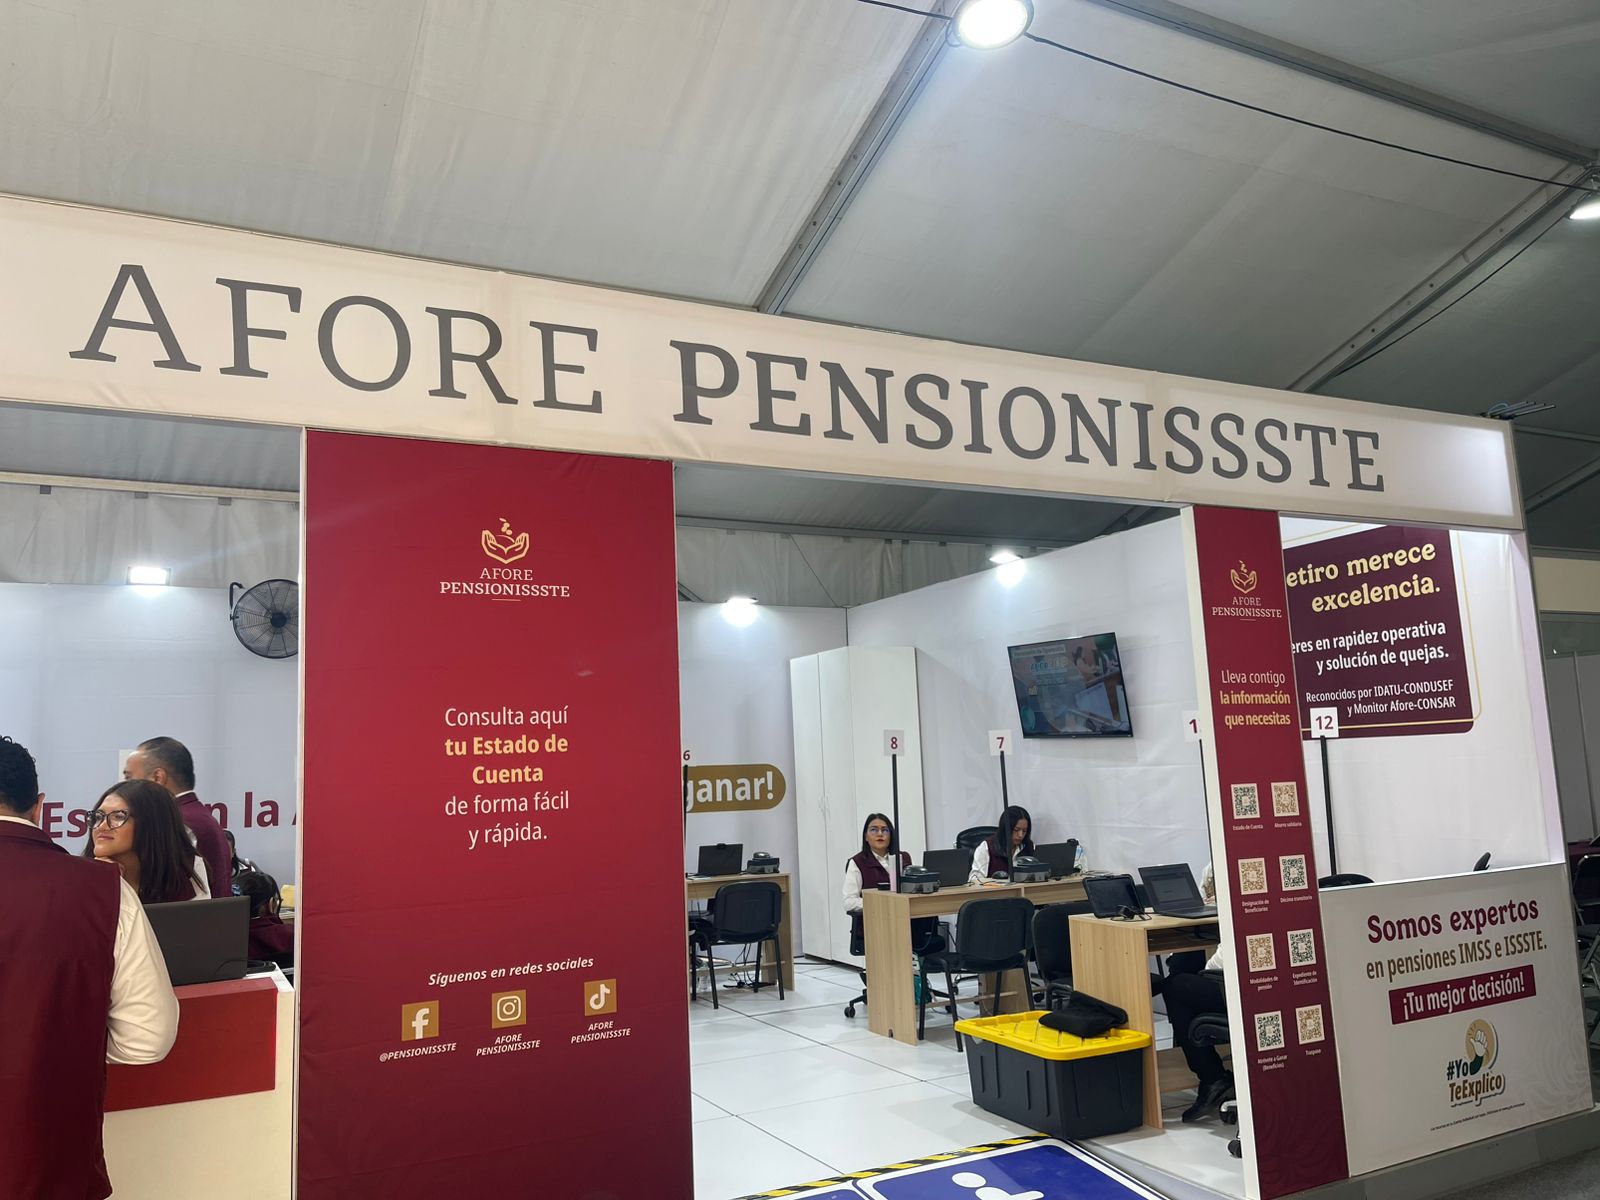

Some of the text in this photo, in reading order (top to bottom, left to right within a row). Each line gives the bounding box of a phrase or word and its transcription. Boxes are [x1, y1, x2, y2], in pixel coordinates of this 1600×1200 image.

[69, 264, 1385, 492] AFORE PENSIONISSSTE
[480, 567, 533, 581] AFORE
[1286, 542, 1436, 588] etiro merece
[439, 581, 570, 597] PENSIONISSSTE
[1311, 573, 1441, 613] excelencia.
[1232, 596, 1261, 606] AFORE
[1212, 606, 1282, 618] PENSIONISSSTE
[1315, 638, 1331, 651] en
[1333, 629, 1379, 651] rapidez
[1381, 620, 1447, 646] operativa
[1316, 644, 1449, 676] y solución de quejas.
[1221, 669, 1286, 687] Lleva contigo
[1220, 690, 1291, 704] la información
[1306, 679, 1454, 703] Reconocidos por IDATU-CONDUSEF
[1347, 696, 1457, 717] y Monitor Afore-CONSAR
[444, 705, 569, 730] Consulta aquí
[1224, 711, 1291, 730] que necesitas
[1315, 715, 1334, 731] 12
[444, 733, 569, 756] tu Estado de
[890, 736, 898, 750] 8
[996, 737, 1005, 750] 7
[683, 750, 691, 761] 6
[472, 765, 544, 785] Cuenta
[244, 791, 279, 828] la
[444, 790, 570, 815] de forma fácil
[468, 821, 548, 850] y rápida.
[1367, 899, 1539, 943] Somos expertos
[1366, 930, 1547, 983] en pensiones IMSS e ISSSTE.
[428, 956, 594, 988] Síguenos en redes sociales
[1402, 971, 1526, 1021] ¡Tu mejor decisión!
[570, 1028, 631, 1044] PENSIONISSSTE
[588, 1020, 614, 1032] AFORE
[475, 1039, 541, 1056] PENSIONISSSTE
[494, 1033, 522, 1045] AFORE
[379, 1042, 457, 1063] @PENSIONISSSTE
[1446, 1058, 1469, 1081] #Yo
[1449, 1072, 1503, 1102] TeExplico
